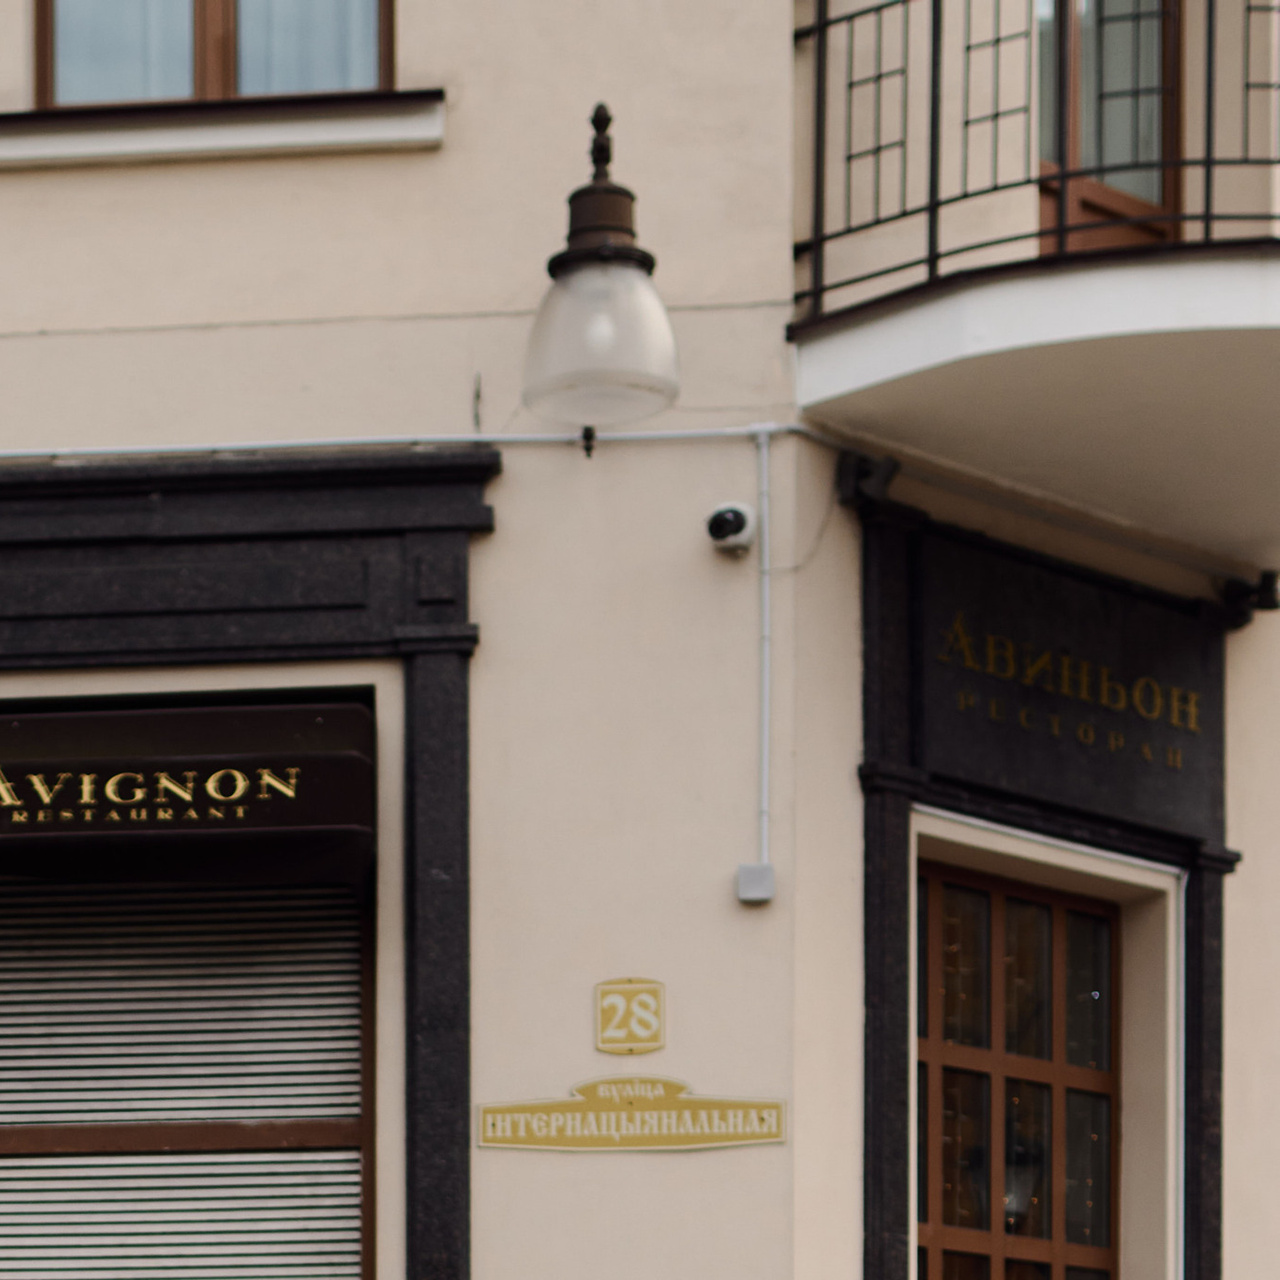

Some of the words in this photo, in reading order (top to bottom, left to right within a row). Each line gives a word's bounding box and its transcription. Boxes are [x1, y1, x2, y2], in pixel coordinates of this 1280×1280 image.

[936, 610, 1202, 734] АВИНЬОН
[11, 805, 249, 823] RESTAURANT
[602, 993, 660, 1040] 28
